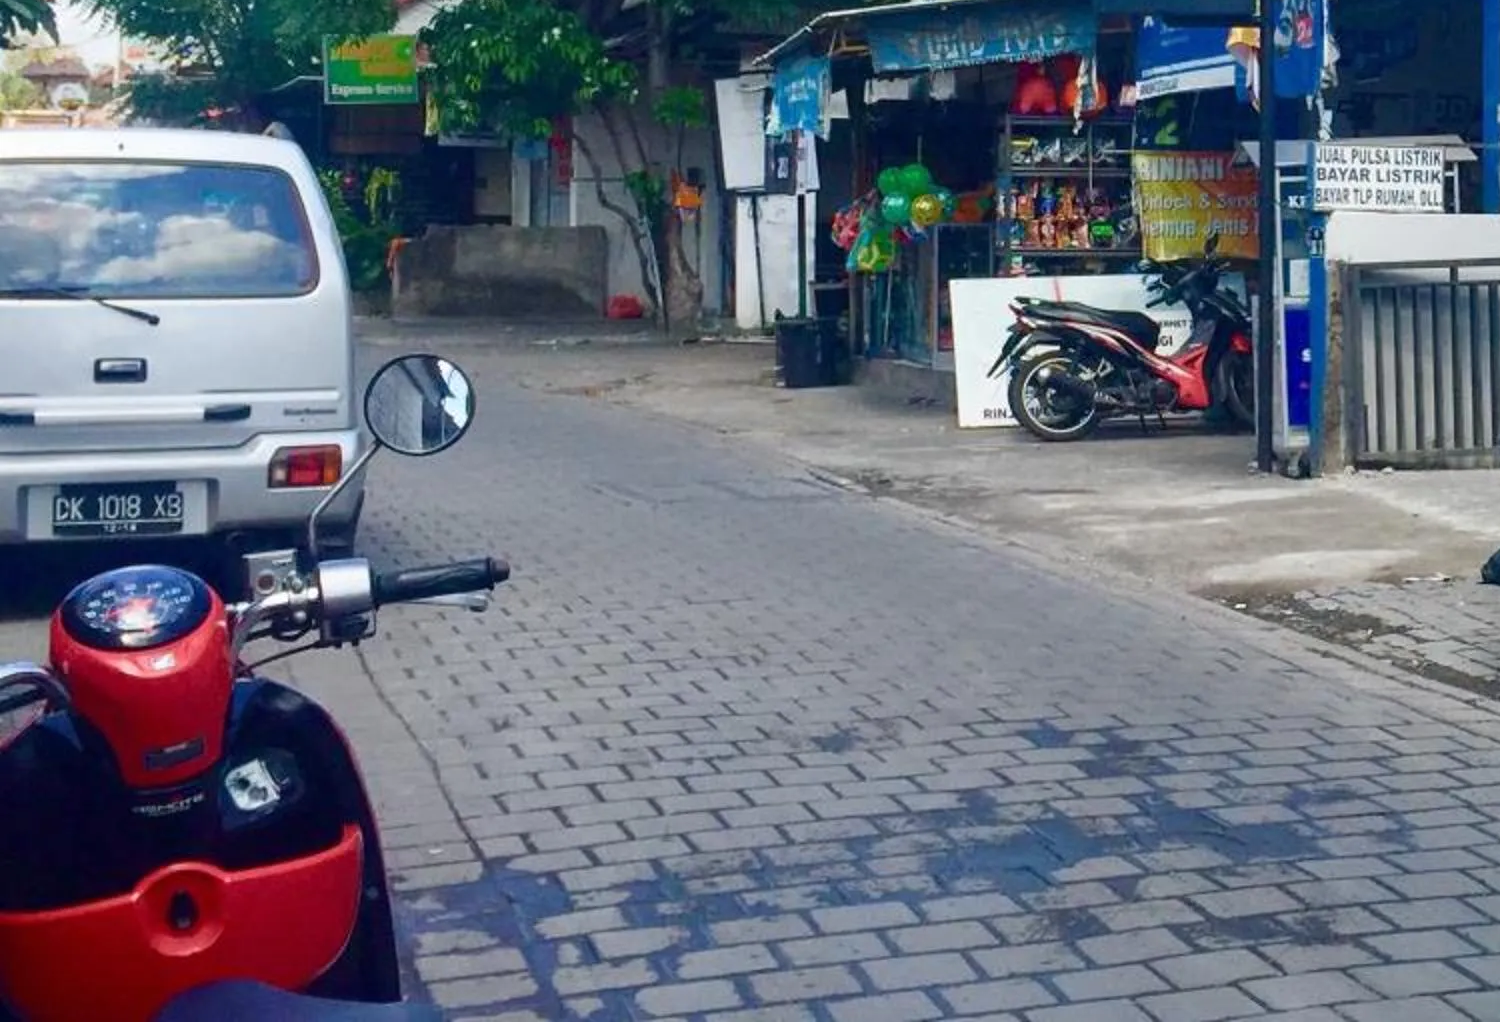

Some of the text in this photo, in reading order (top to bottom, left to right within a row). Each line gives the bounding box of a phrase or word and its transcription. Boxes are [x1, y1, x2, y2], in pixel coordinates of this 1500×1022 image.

[1316, 145, 1441, 167] JUAL PULSA LISTRIK
[1317, 167, 1441, 184] BAYAR LISTRIK
[1315, 187, 1350, 204] BAYAR
[1353, 188, 1374, 205] TLP
[55, 493, 182, 521] DK 1018 XB
